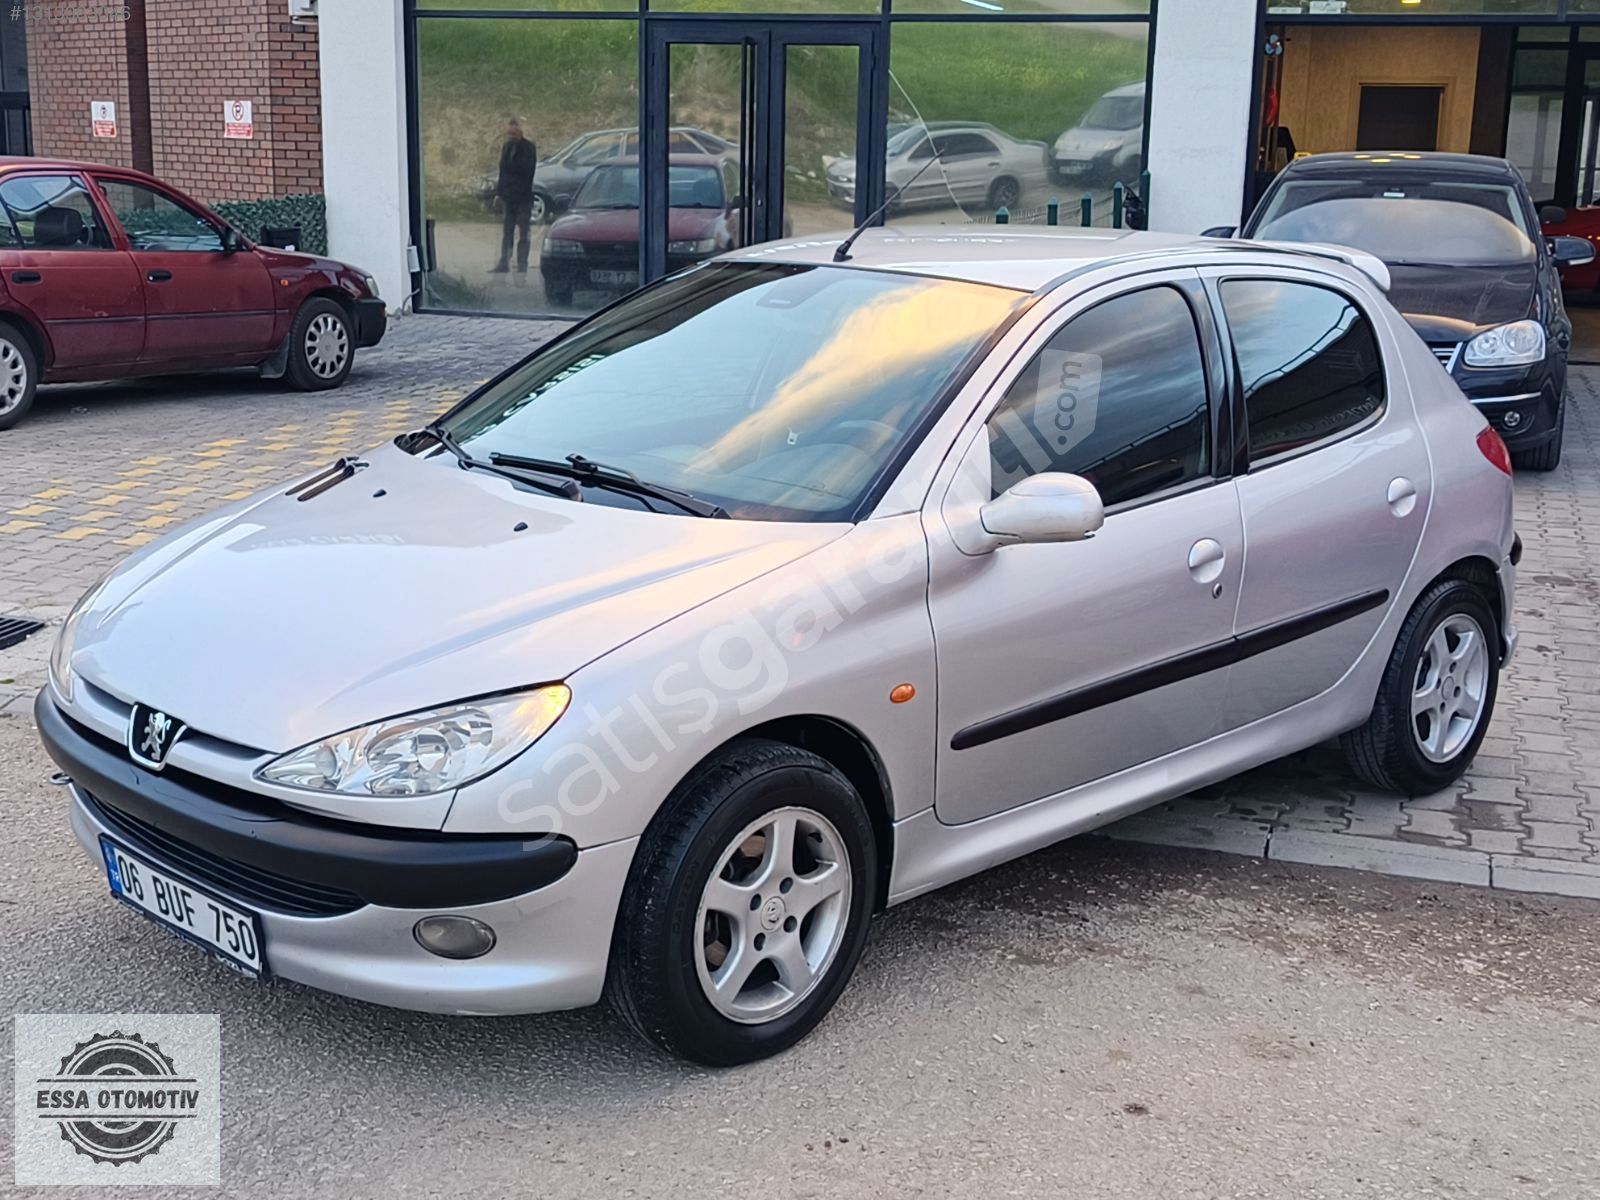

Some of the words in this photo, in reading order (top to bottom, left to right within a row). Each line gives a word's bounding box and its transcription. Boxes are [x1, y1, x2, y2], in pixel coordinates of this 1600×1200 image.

[118, 854, 144, 901] 06
[152, 874, 195, 927] BUF
[208, 902, 256, 961] 750
